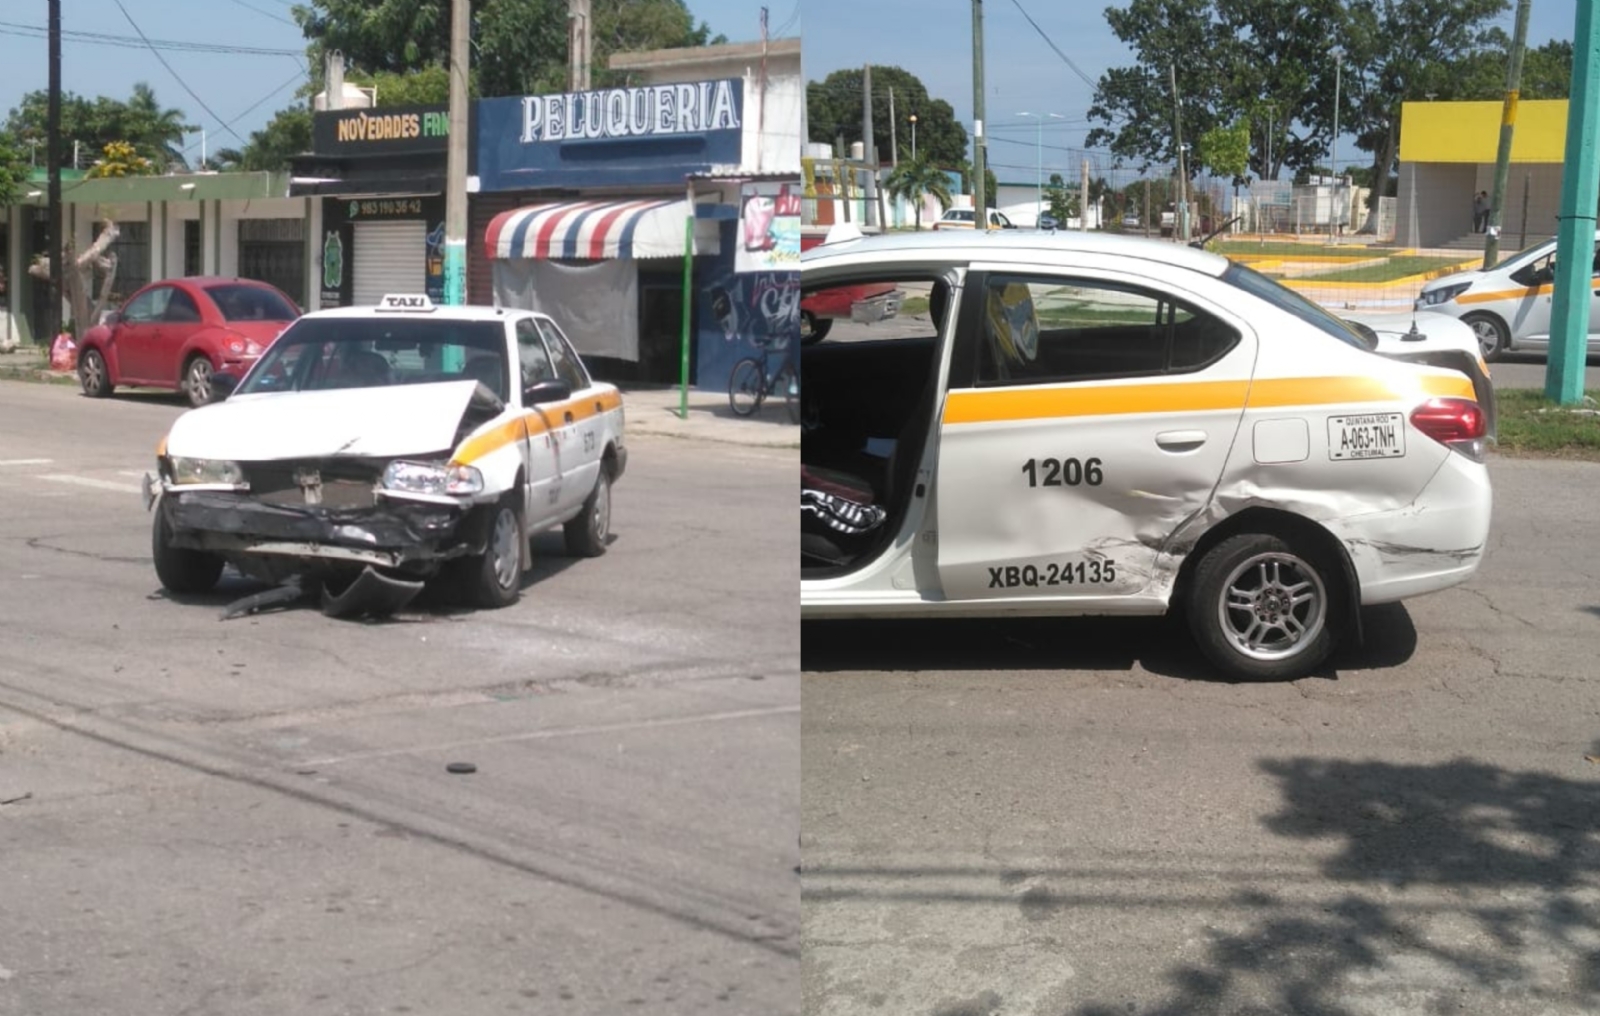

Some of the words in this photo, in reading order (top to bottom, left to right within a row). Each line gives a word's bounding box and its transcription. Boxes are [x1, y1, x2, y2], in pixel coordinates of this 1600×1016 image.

[520, 80, 741, 143] PELUQUERIA
[338, 112, 420, 142] NOVEDADES
[386, 297, 425, 307] TAXI
[1341, 425, 1396, 450] A-063-TNH
[1021, 457, 1104, 488] 1206
[987, 559, 1116, 589] XBQ-24135
